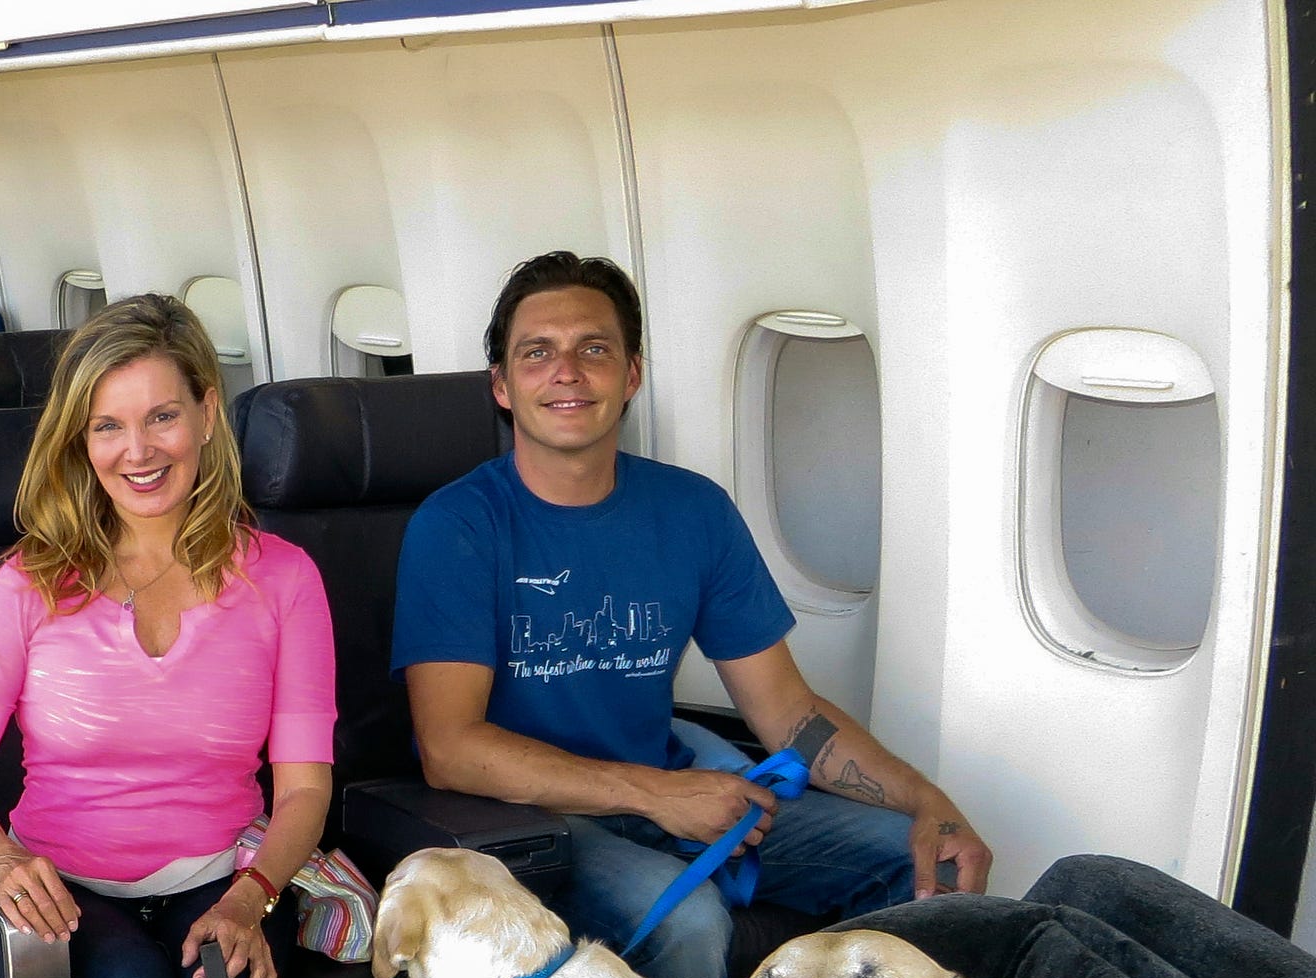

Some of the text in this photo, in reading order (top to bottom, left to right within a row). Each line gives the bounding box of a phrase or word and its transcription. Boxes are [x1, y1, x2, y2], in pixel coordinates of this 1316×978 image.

[508, 660, 532, 678] The
[534, 660, 566, 683] safest
[598, 658, 613, 670] in
[613, 653, 633, 670] the
[636, 648, 670, 668] world!
